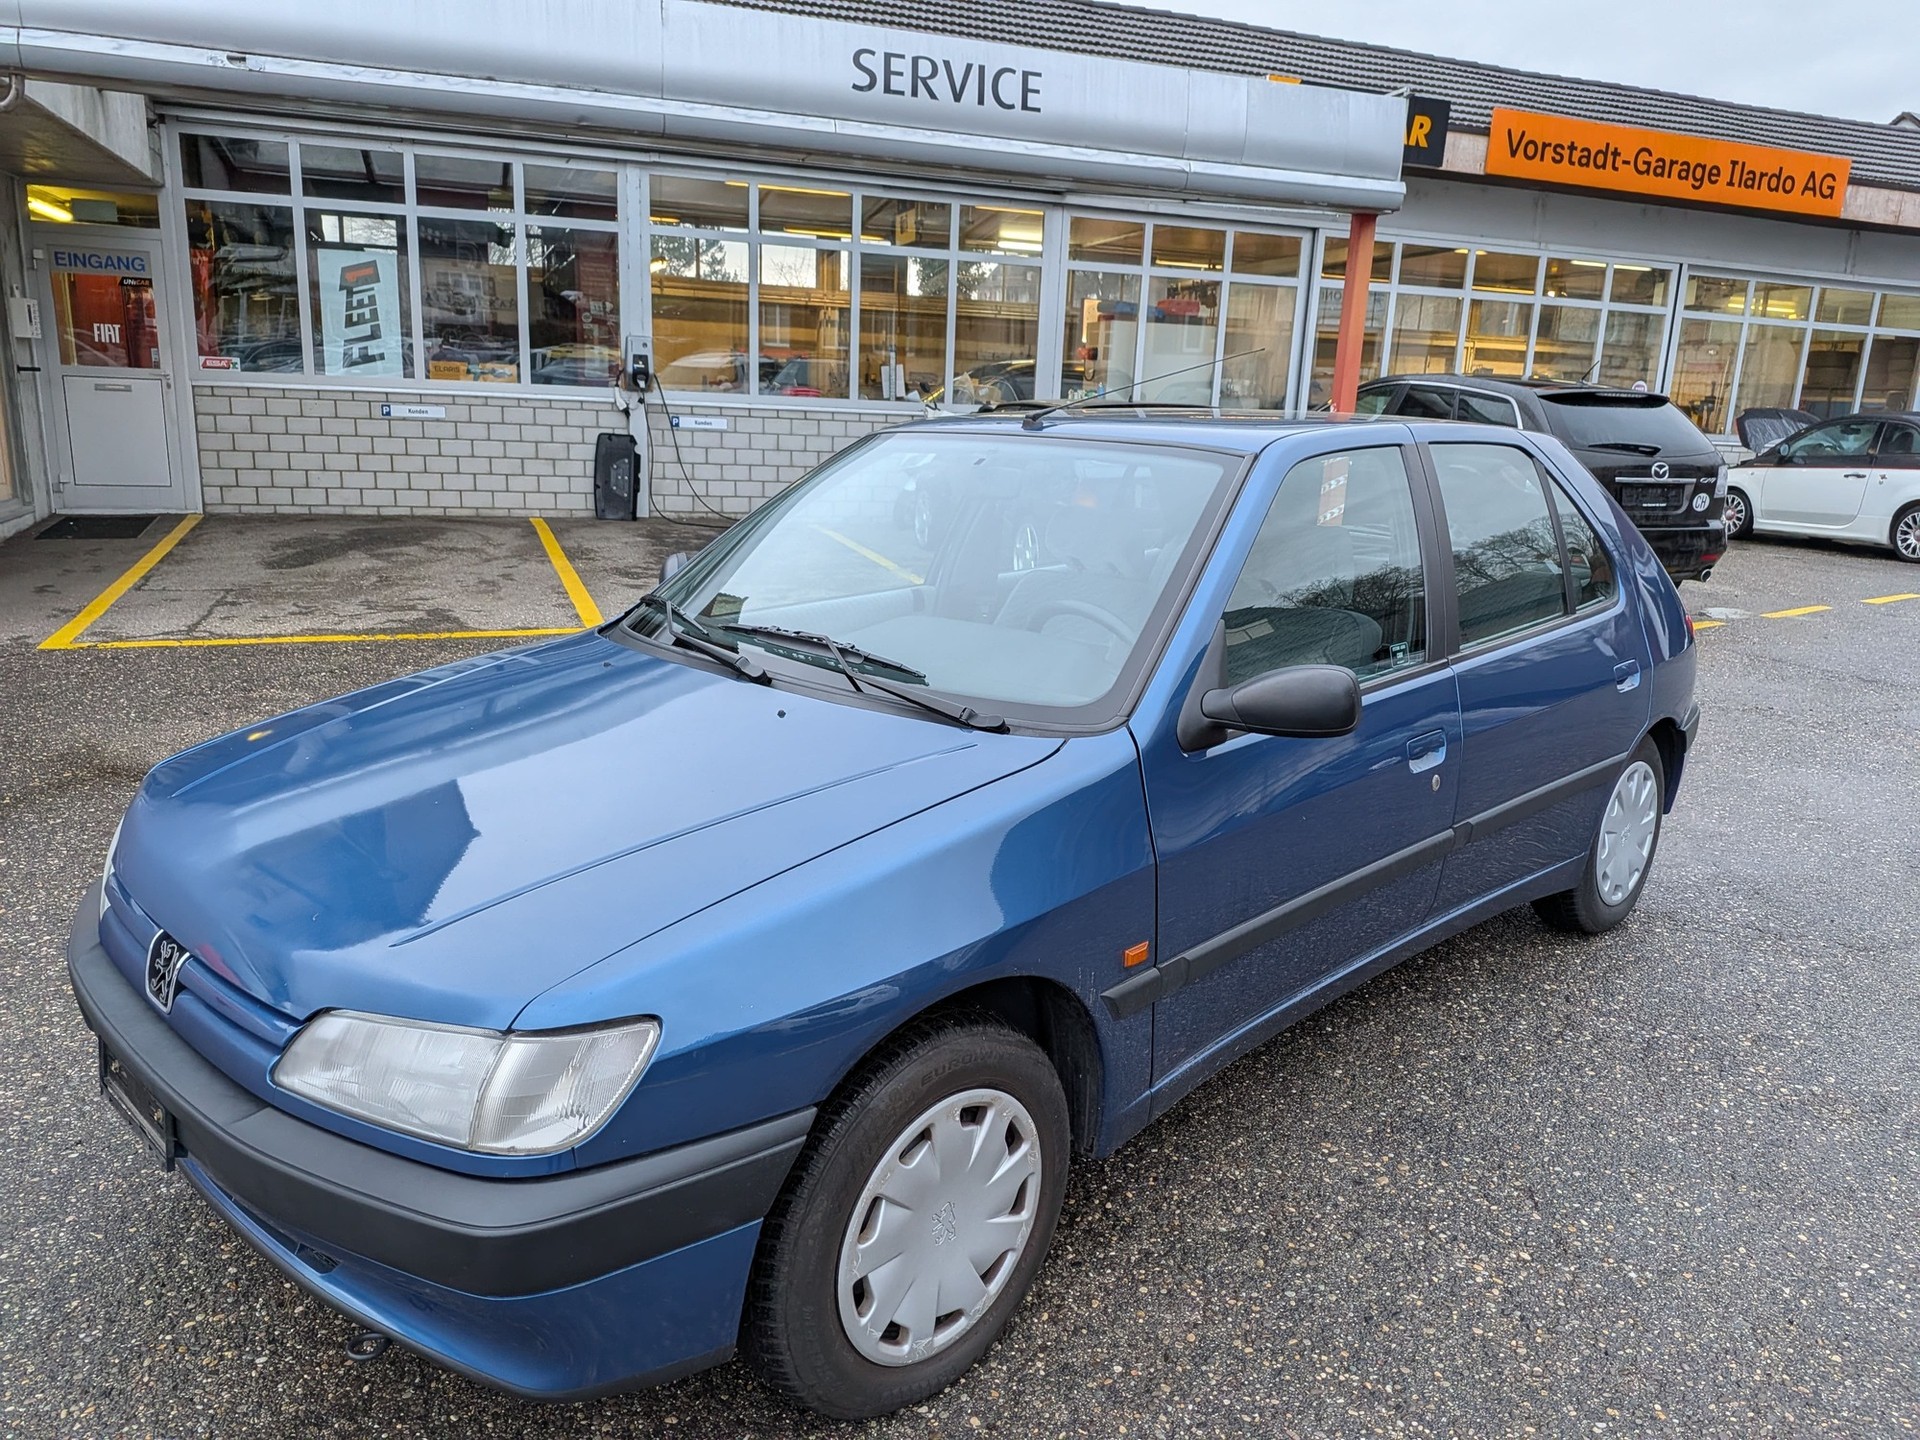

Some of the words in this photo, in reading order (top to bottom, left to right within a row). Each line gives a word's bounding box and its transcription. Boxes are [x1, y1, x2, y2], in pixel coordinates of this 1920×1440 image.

[851, 48, 1043, 113] SERVICE
[1507, 128, 1721, 190] Vorstadt-Garage
[1726, 160, 1796, 194] Ilardo
[1801, 170, 1837, 199] AG
[54, 251, 146, 272] EINGANG
[93, 323, 121, 343] FIAT
[434, 365, 460, 373] ELARIS
[382, 406, 390, 415] P
[672, 418, 679, 426] P
[1695, 494, 1707, 509] CH
